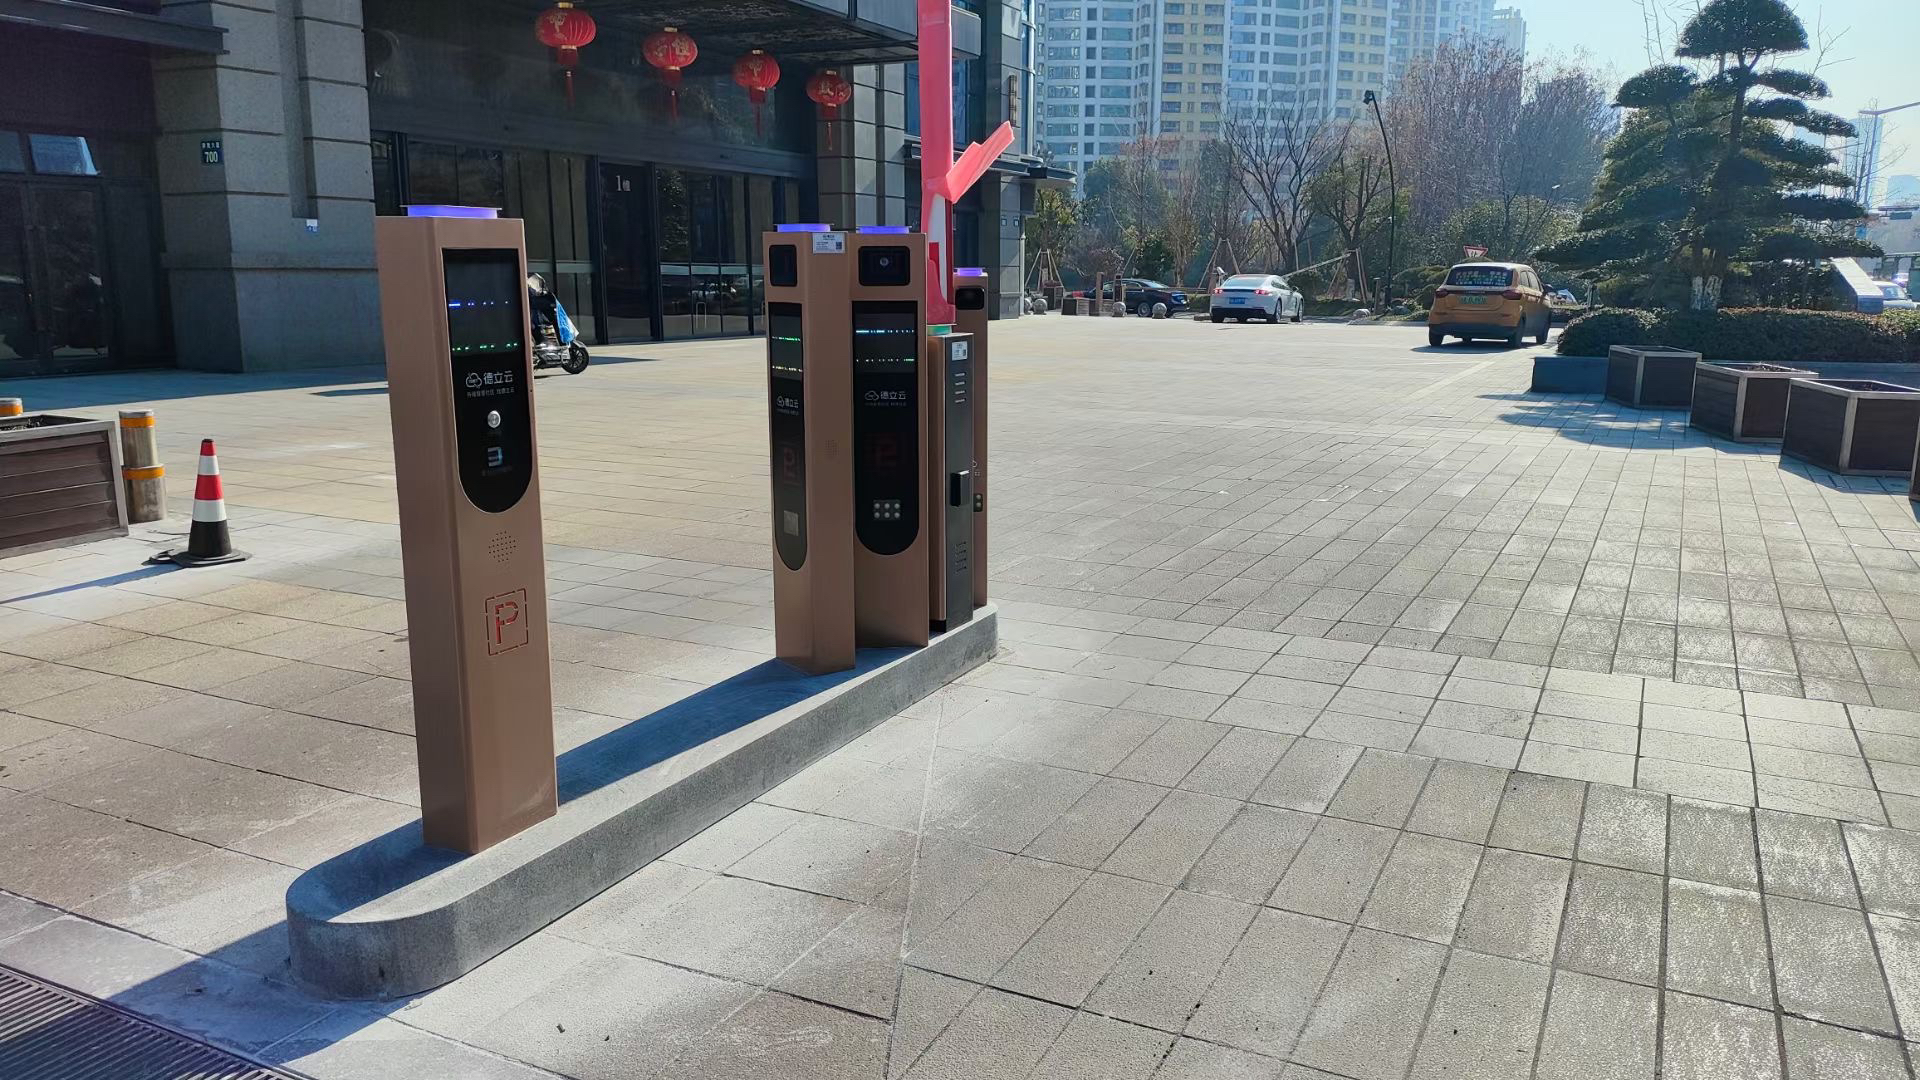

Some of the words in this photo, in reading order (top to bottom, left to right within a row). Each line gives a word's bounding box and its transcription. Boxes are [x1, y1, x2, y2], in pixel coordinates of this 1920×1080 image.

[204, 151, 218, 162] 700
[483, 370, 513, 385] 德立云
[880, 390, 906, 399] 德立云
[495, 601, 519, 644] P
